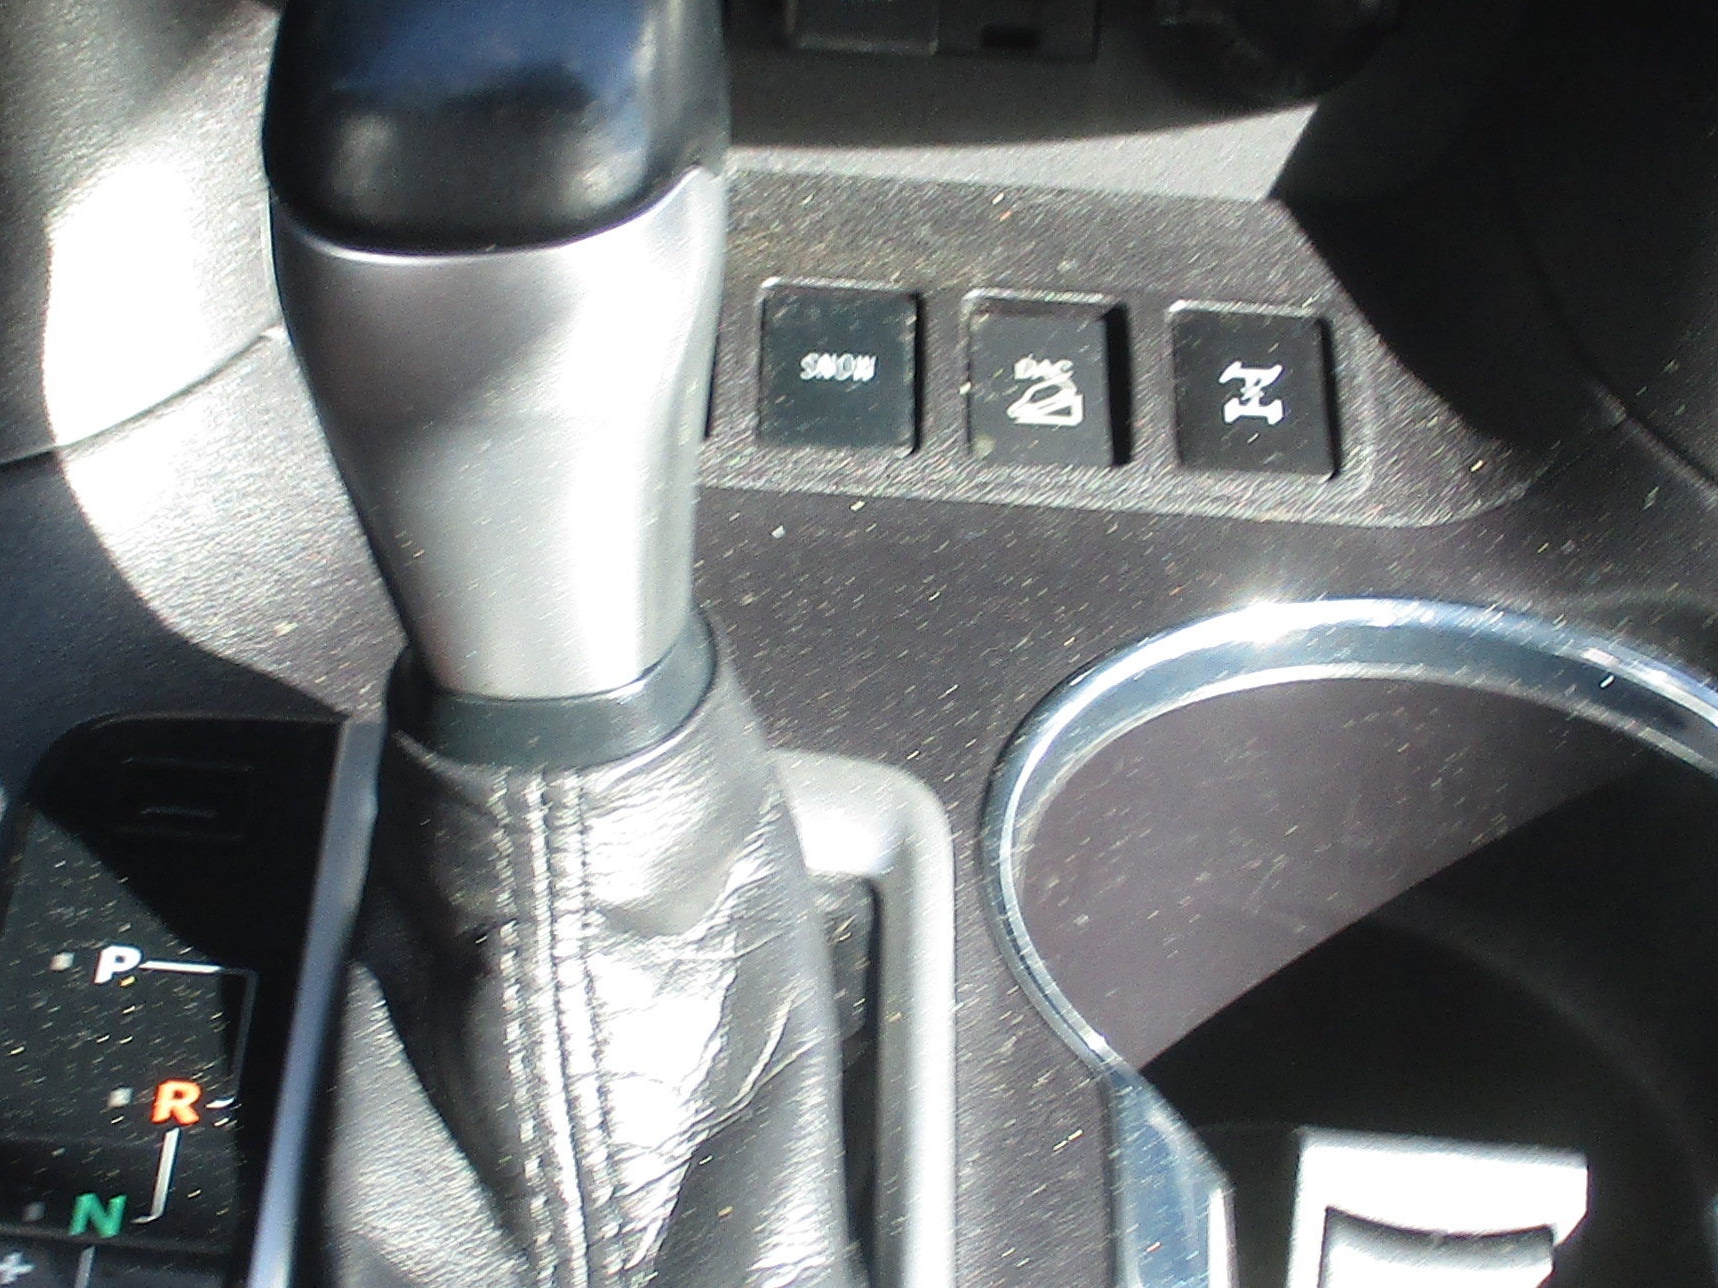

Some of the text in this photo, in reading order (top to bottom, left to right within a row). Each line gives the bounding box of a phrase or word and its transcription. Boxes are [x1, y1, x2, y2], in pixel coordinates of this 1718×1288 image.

[799, 352, 878, 383] SNOW
[93, 944, 144, 985] P
[150, 1078, 203, 1126] R
[68, 1192, 127, 1238] N
